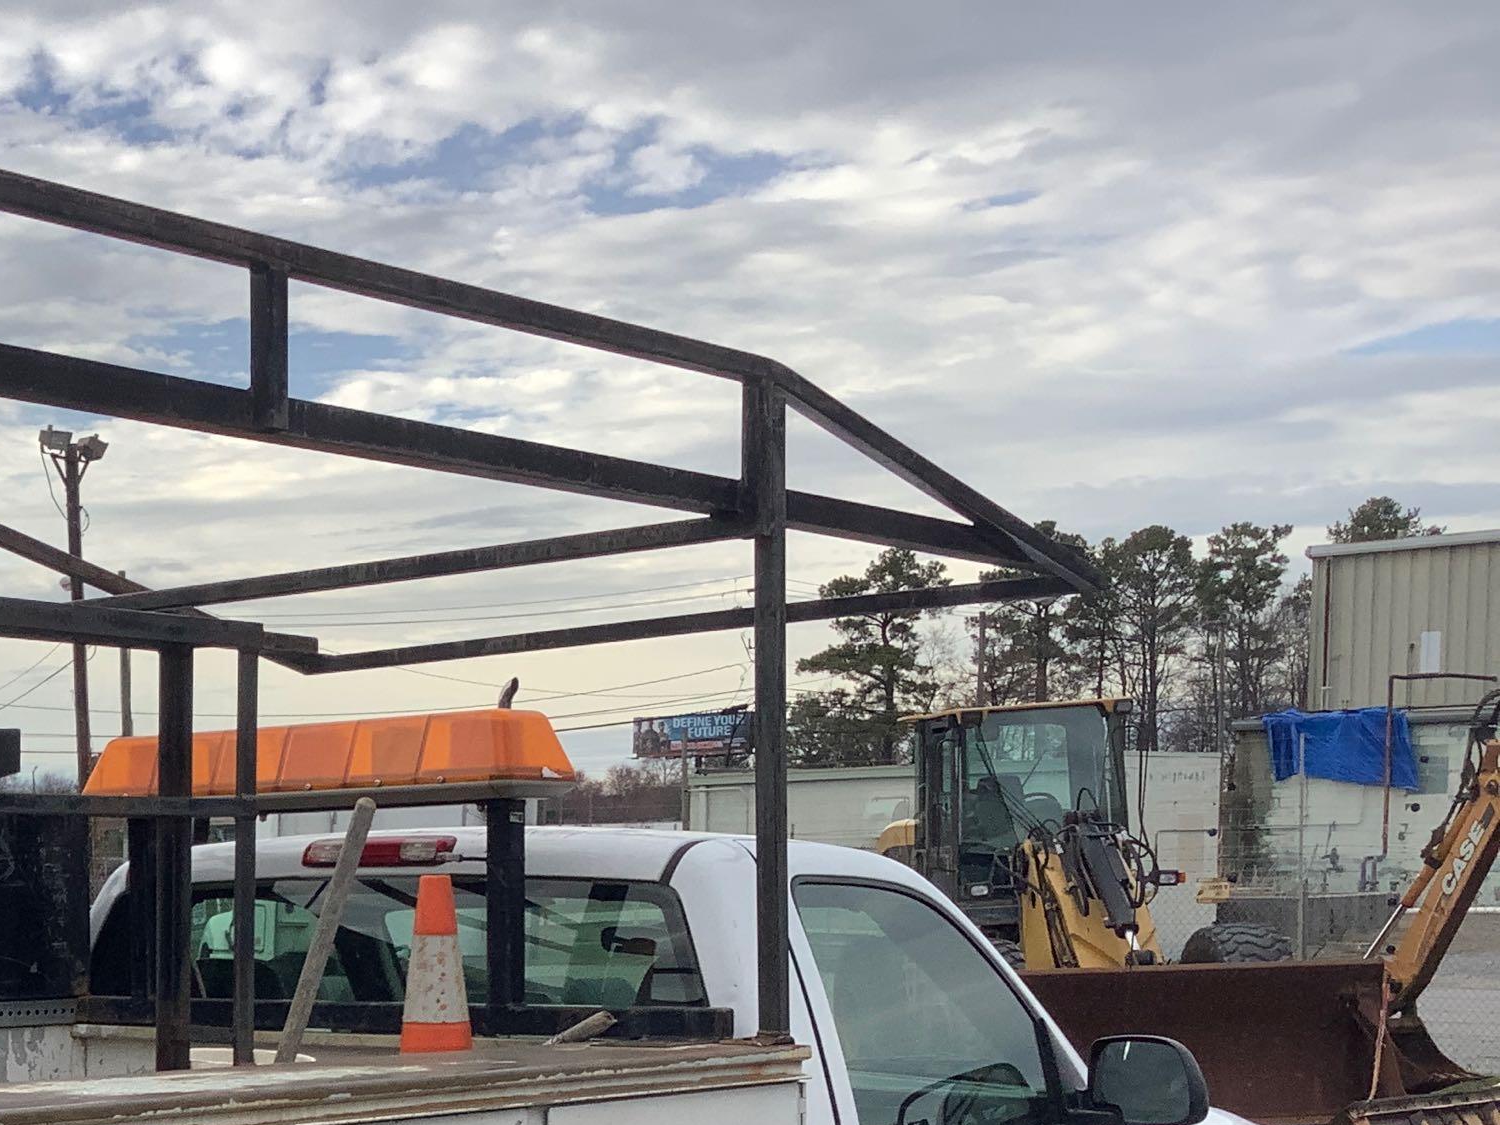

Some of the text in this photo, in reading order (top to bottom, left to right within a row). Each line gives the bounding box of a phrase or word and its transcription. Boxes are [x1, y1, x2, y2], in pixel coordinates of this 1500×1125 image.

[672, 717, 711, 728] DEFINE
[687, 725, 731, 738] FUTURE
[1442, 820, 1485, 895] CASE
